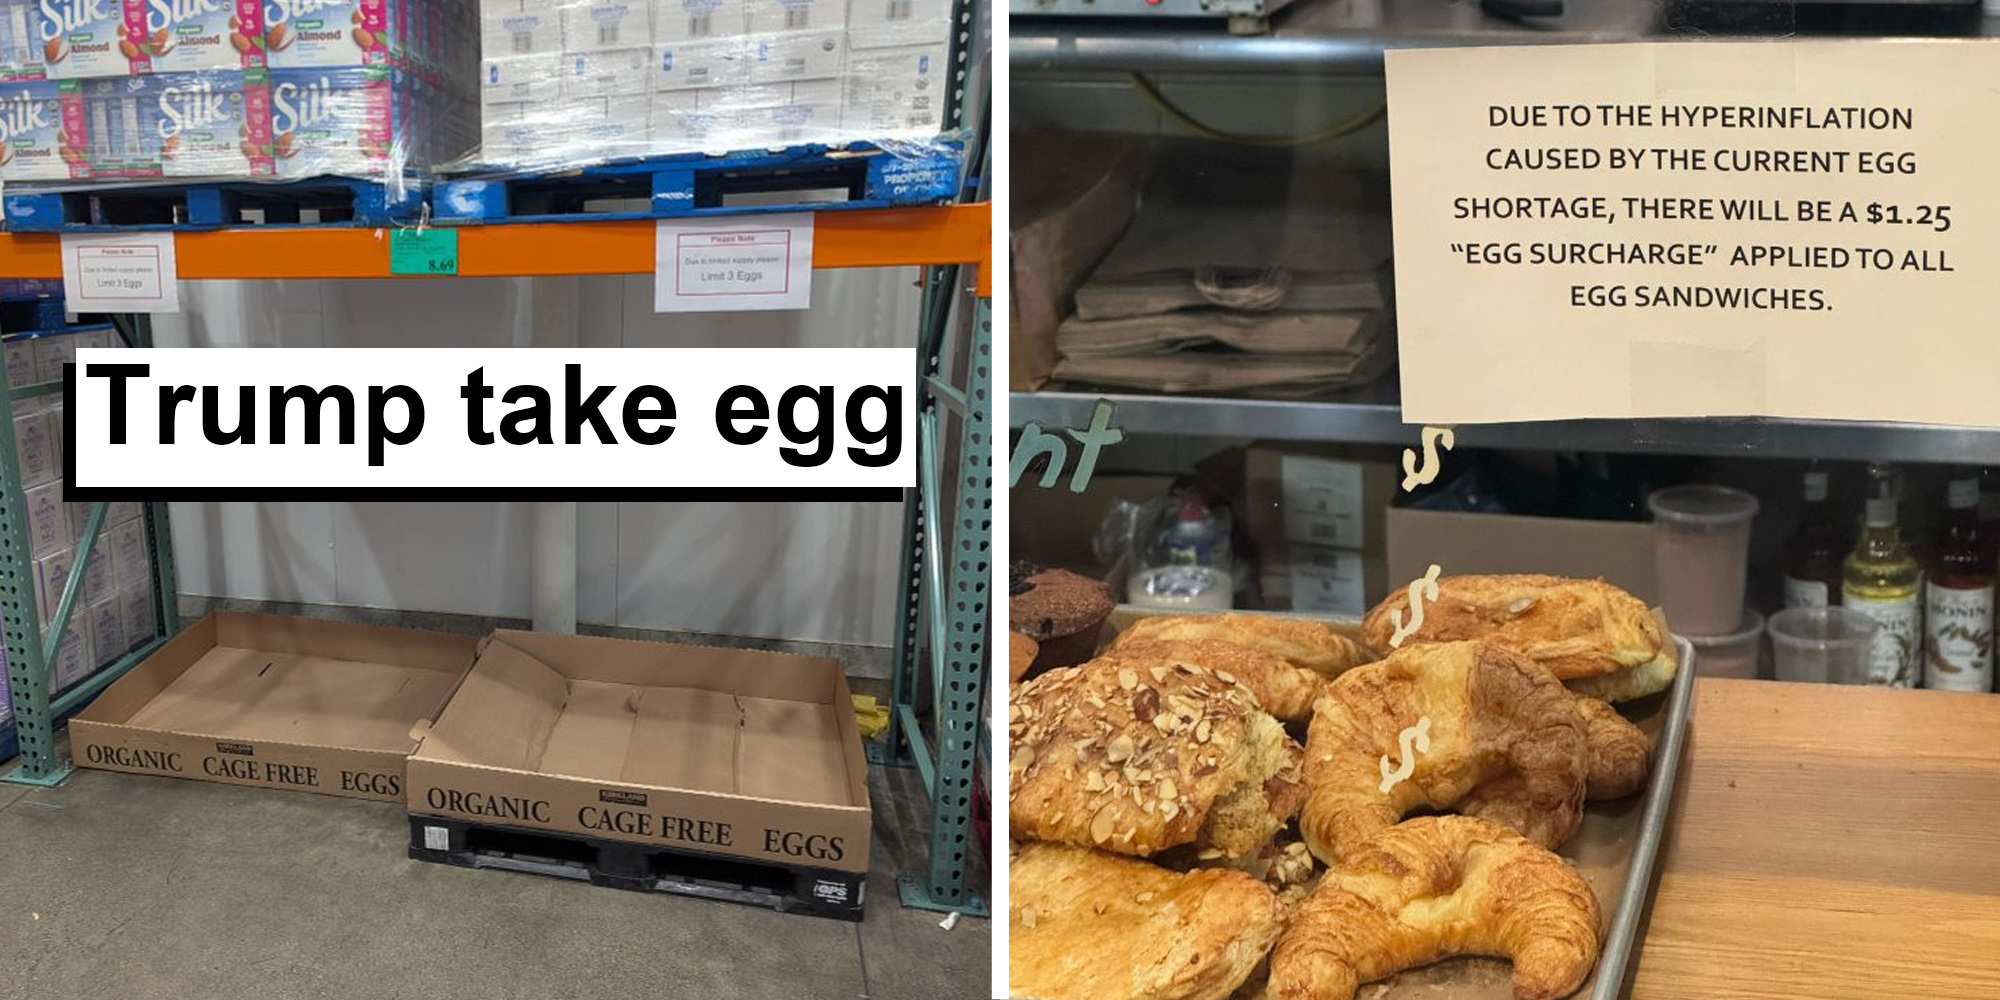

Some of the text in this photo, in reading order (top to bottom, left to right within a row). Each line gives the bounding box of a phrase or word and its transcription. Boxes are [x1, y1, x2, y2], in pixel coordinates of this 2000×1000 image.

[71, 42, 110, 53] Almond
[297, 30, 341, 41] Almond
[158, 78, 231, 138] Silk
[1489, 105, 1912, 130] DUE TO THE HYPERINFLATION
[1486, 148, 1916, 175] CAUSED BY THE CURRENT EGG
[1454, 197, 1951, 232] SHORTAGE, THERE WILL BE A $1.25
[428, 258, 454, 272] 8.69
[1450, 243, 1954, 272] “EGG SURCHARGE” APPLIED TO ALL
[701, 270, 763, 282] Limit 3 Eggs
[1571, 285, 1833, 311] EGG SANDWICHES.
[86, 744, 400, 797] ORGANIC CAGE FREE EGGS
[427, 787, 845, 862] ORGANIC CAGE FREE EGGS
